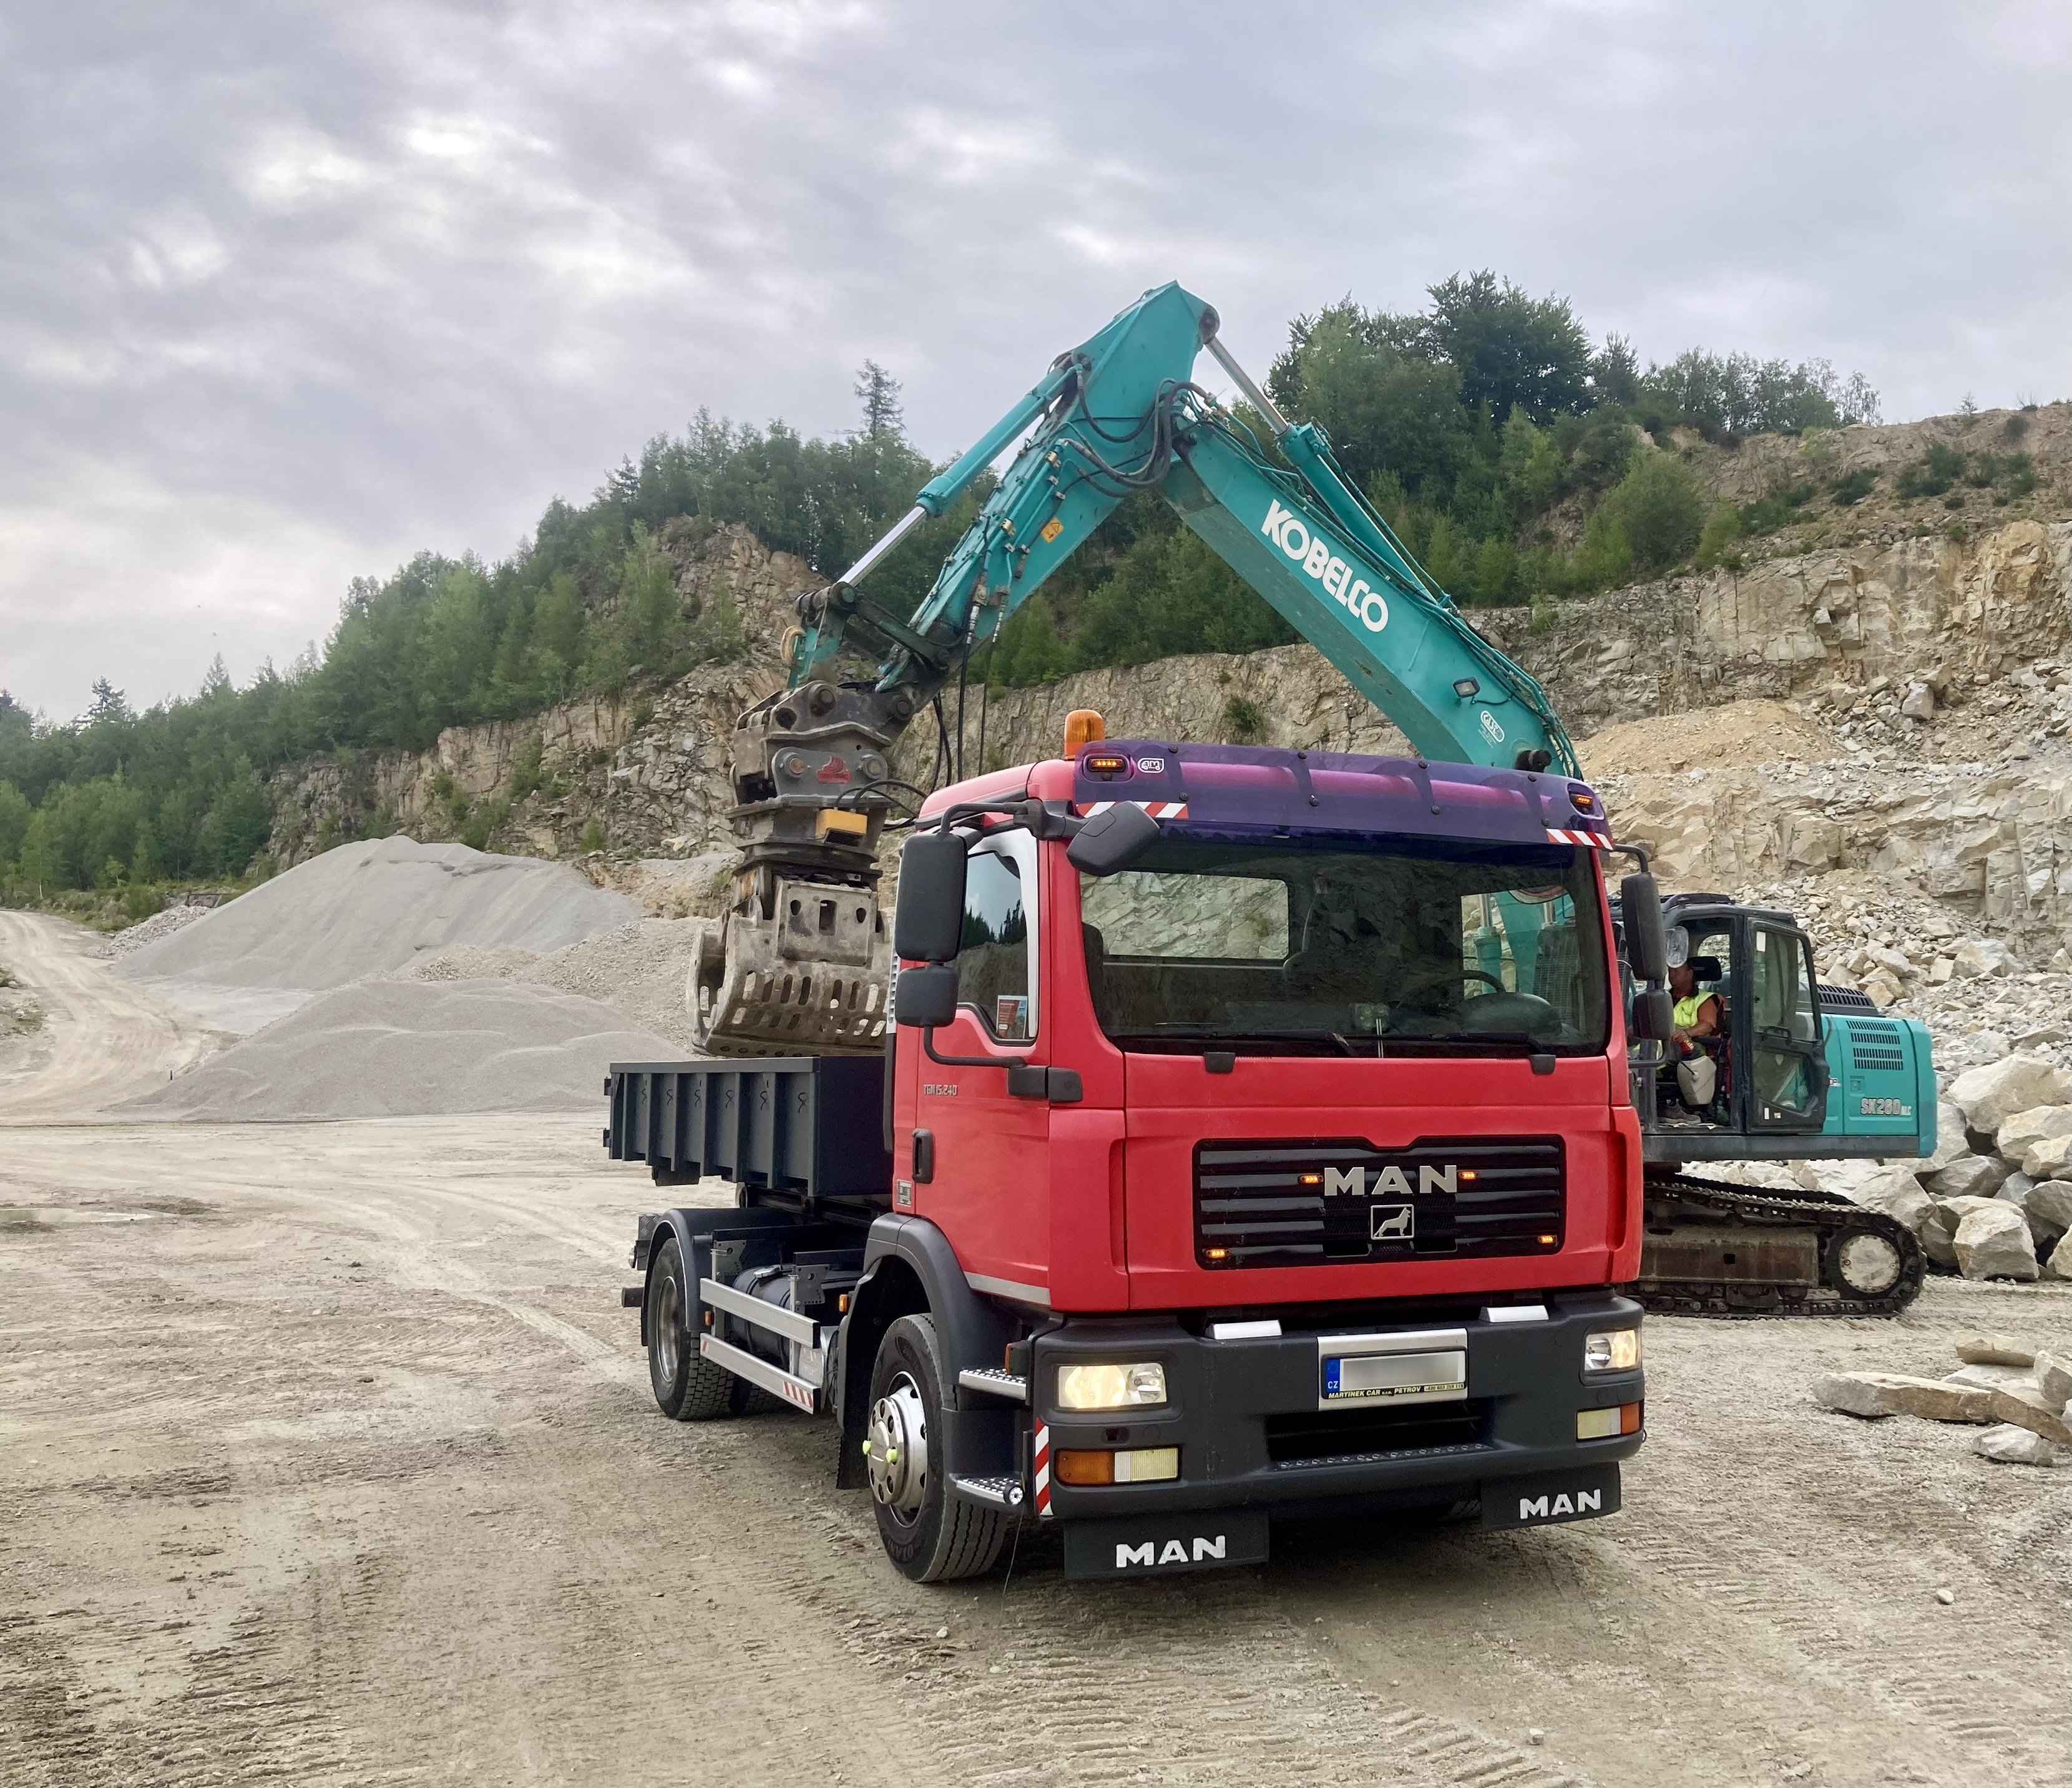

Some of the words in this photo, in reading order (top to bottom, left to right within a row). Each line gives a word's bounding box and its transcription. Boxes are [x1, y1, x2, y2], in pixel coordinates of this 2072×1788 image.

[1261, 499, 1389, 632] KOBELCO
[1324, 1165, 1457, 1196] MAN
[1327, 1380, 1339, 1389] CZ
[1328, 1390, 1365, 1399] MARTINEK
[1394, 1385, 1421, 1394] PETROV
[1519, 1488, 1601, 1520] MAN
[1116, 1535, 1226, 1568] MAN
